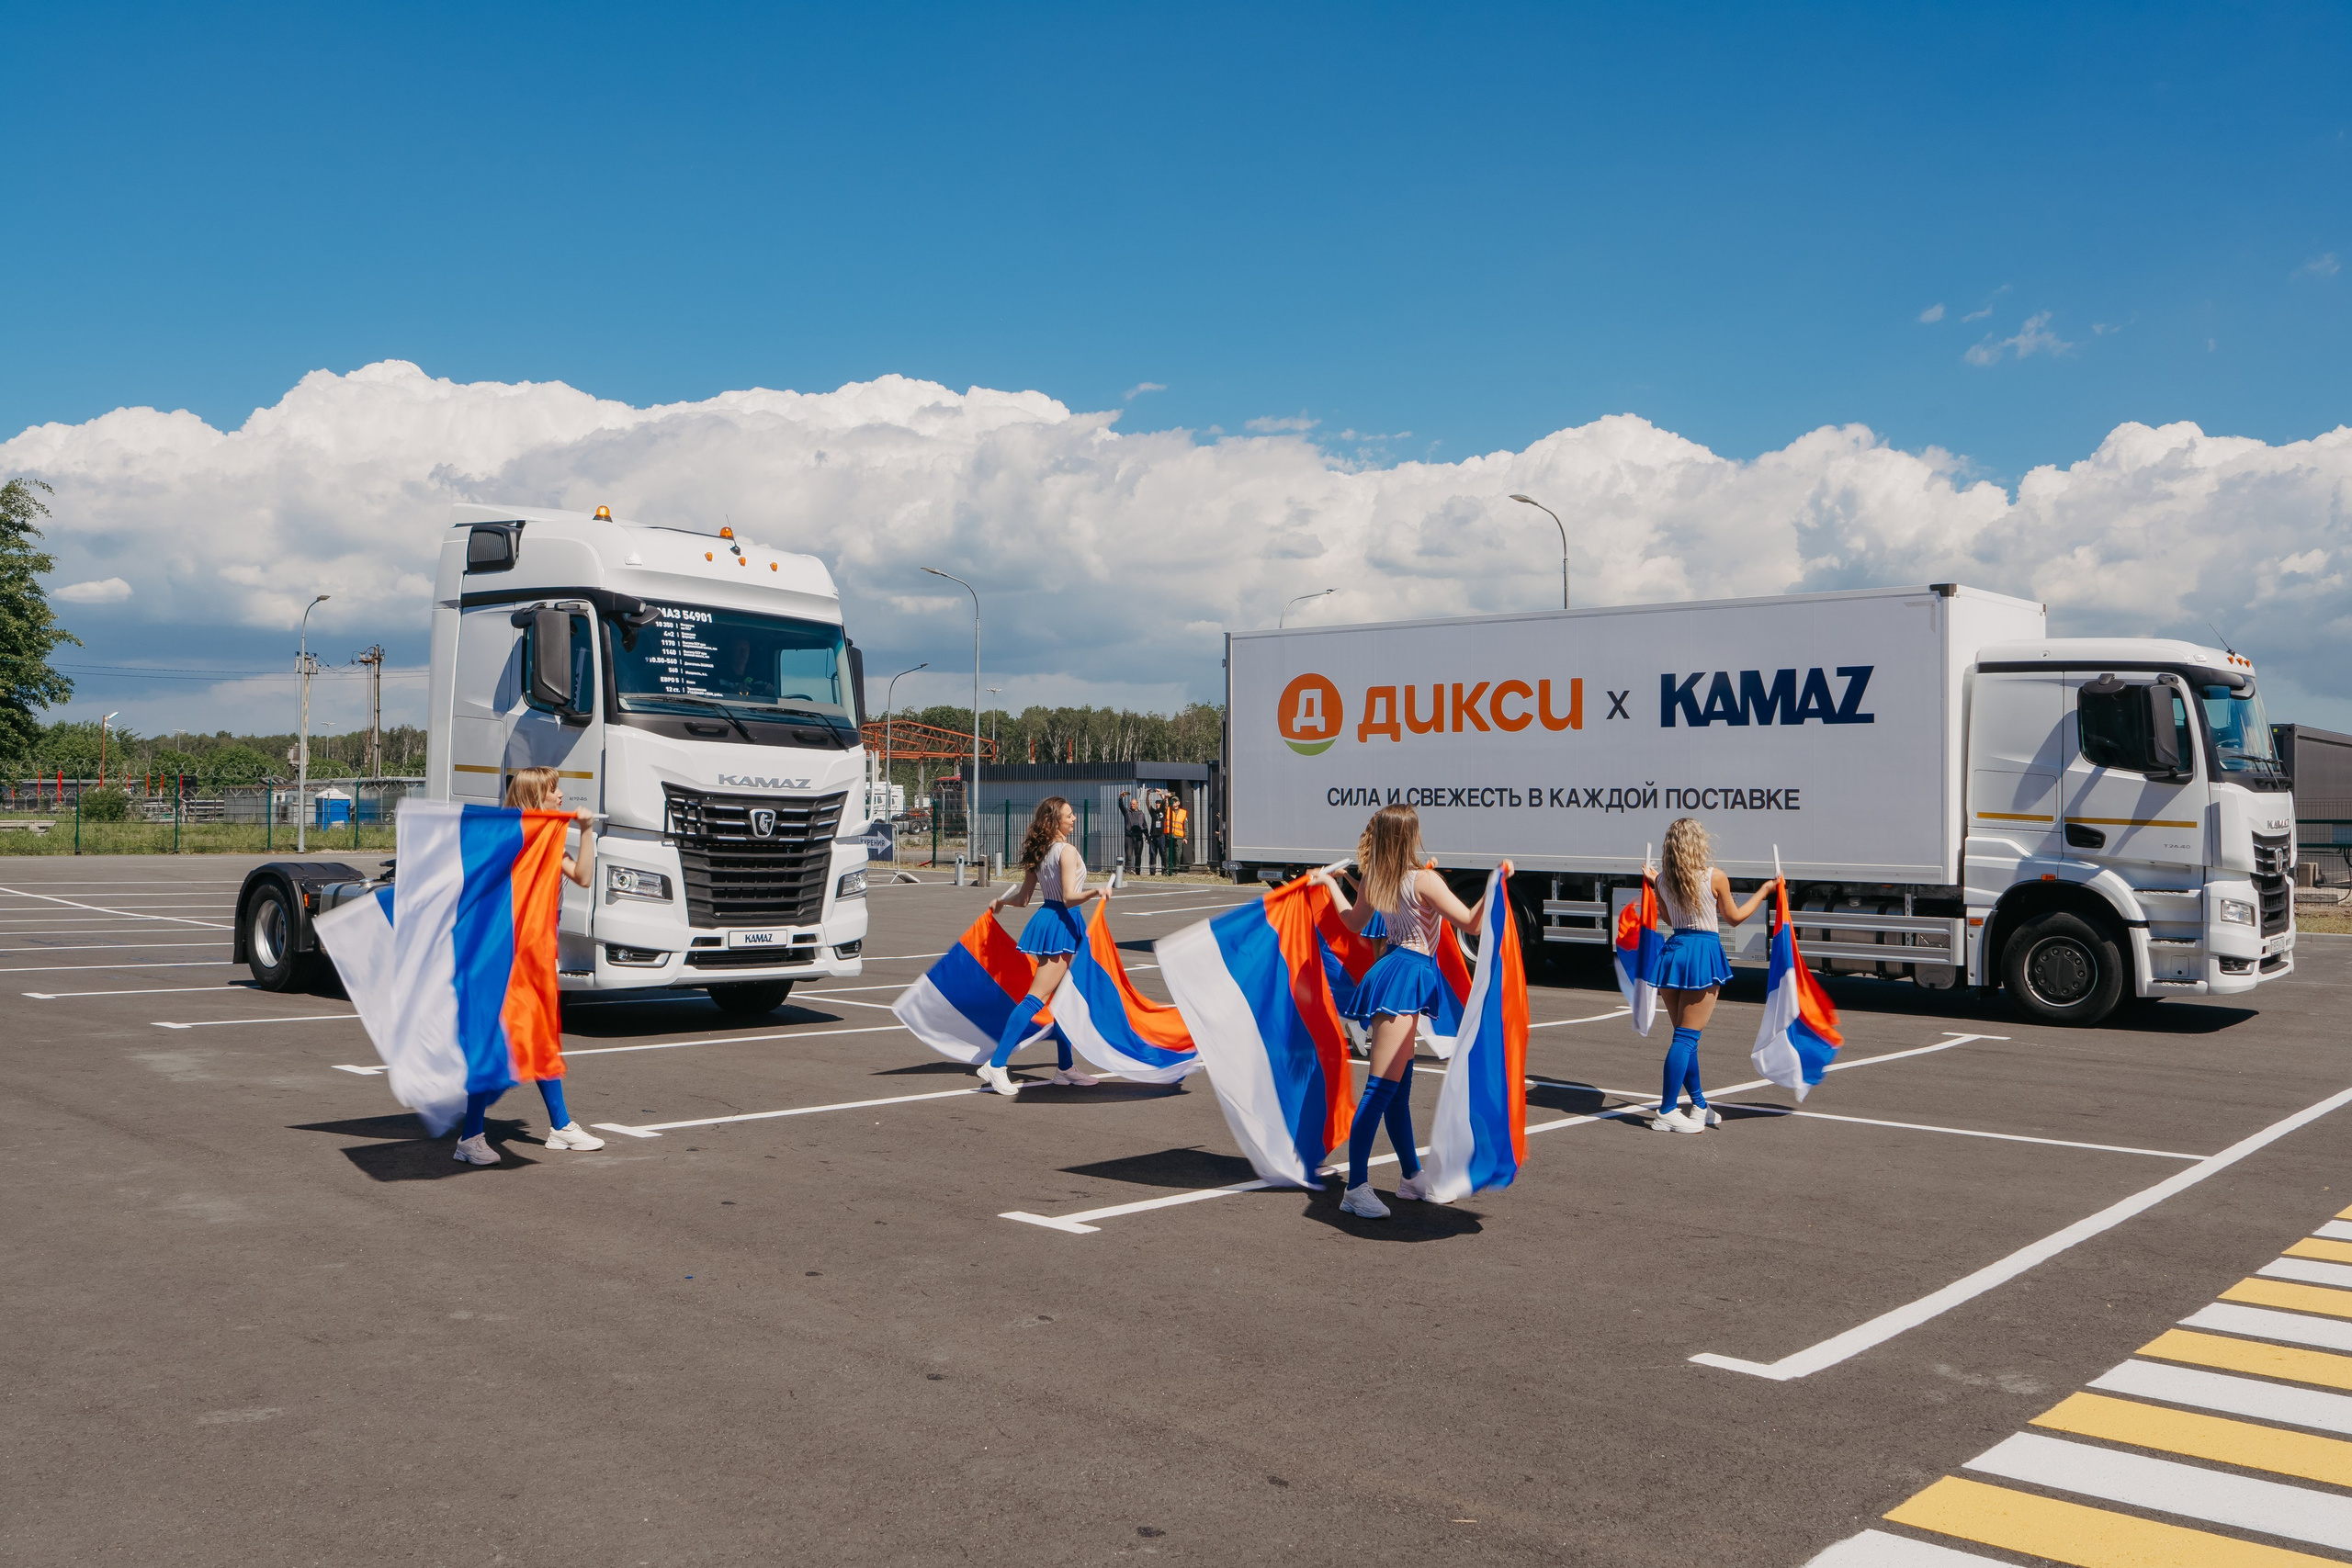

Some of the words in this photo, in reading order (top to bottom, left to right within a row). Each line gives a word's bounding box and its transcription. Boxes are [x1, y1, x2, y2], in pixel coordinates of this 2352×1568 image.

[683, 610, 712, 623] 54901
[1661, 665, 1875, 728] KAMAZ
[718, 773, 811, 789] KAMAZ
[1327, 787, 1382, 807] СИЛА
[1387, 787, 1400, 807] И
[1406, 787, 1522, 808] СВЕЖЕСТЬ
[1528, 788, 1544, 808] В
[1549, 781, 1658, 814] КАЖДОЙ
[1665, 788, 1802, 811] ПОСТАВКЕ
[744, 933, 773, 943] KAMAZ
